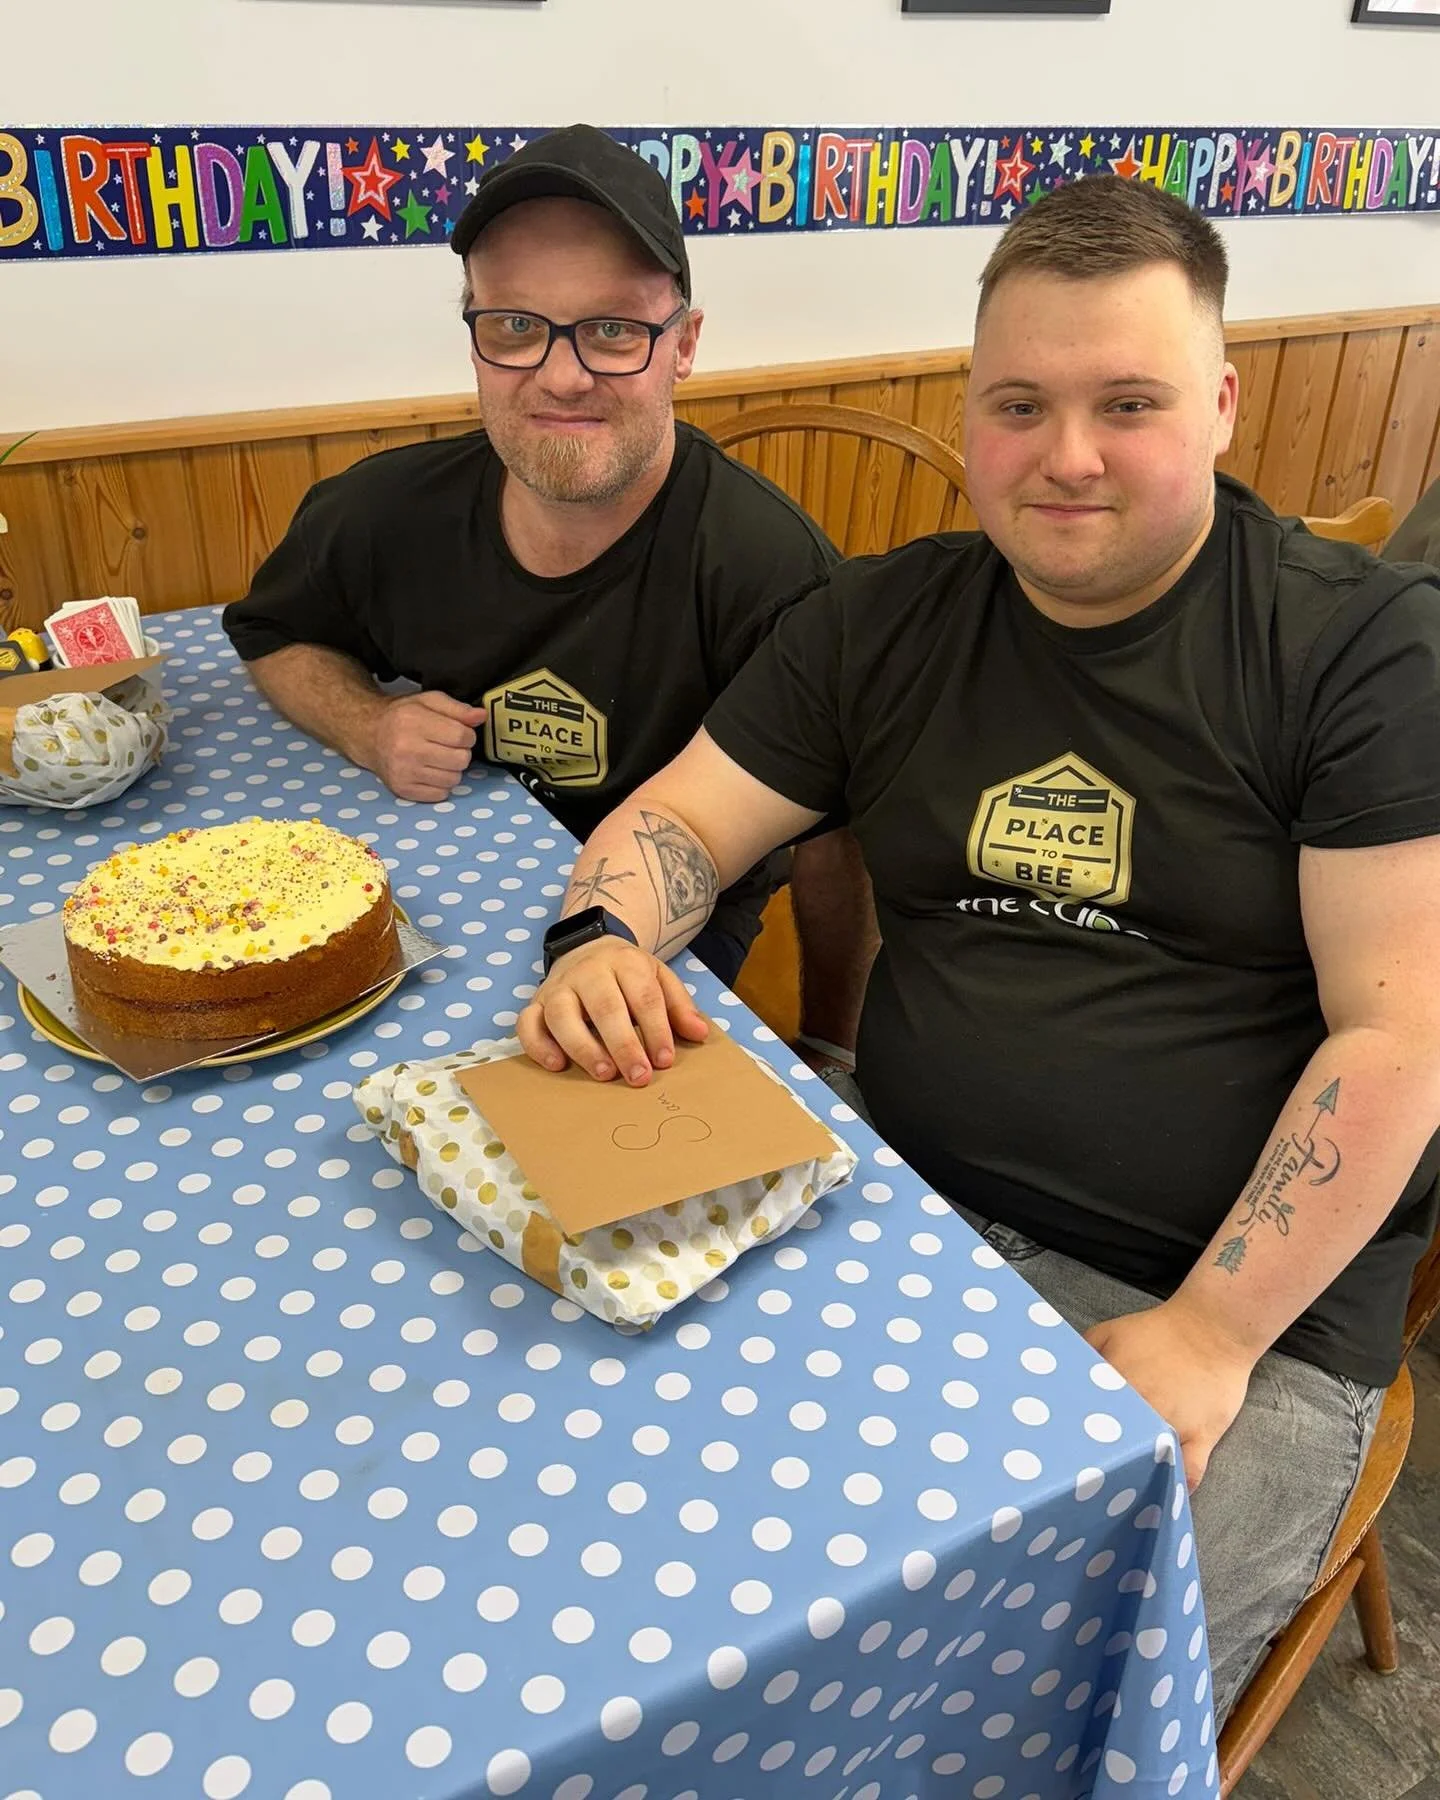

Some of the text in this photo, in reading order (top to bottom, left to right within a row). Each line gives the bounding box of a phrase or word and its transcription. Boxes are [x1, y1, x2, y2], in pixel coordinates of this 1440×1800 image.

[759, 131, 998, 225] BIRTHDAY!
[1140, 130, 1440, 212] HAPPY BIRTHDAY!
[0, 132, 346, 251] BIRTHDAY!
[533, 699, 559, 713] THE
[508, 718, 583, 747] PLACE
[539, 744, 552, 754] TO
[1048, 793, 1077, 807] THE
[1005, 818, 1105, 846] PLACE
[1041, 849, 1058, 859] TO
[1015, 861, 1073, 888] BEE
[1236, 1132, 1341, 1236] Family
